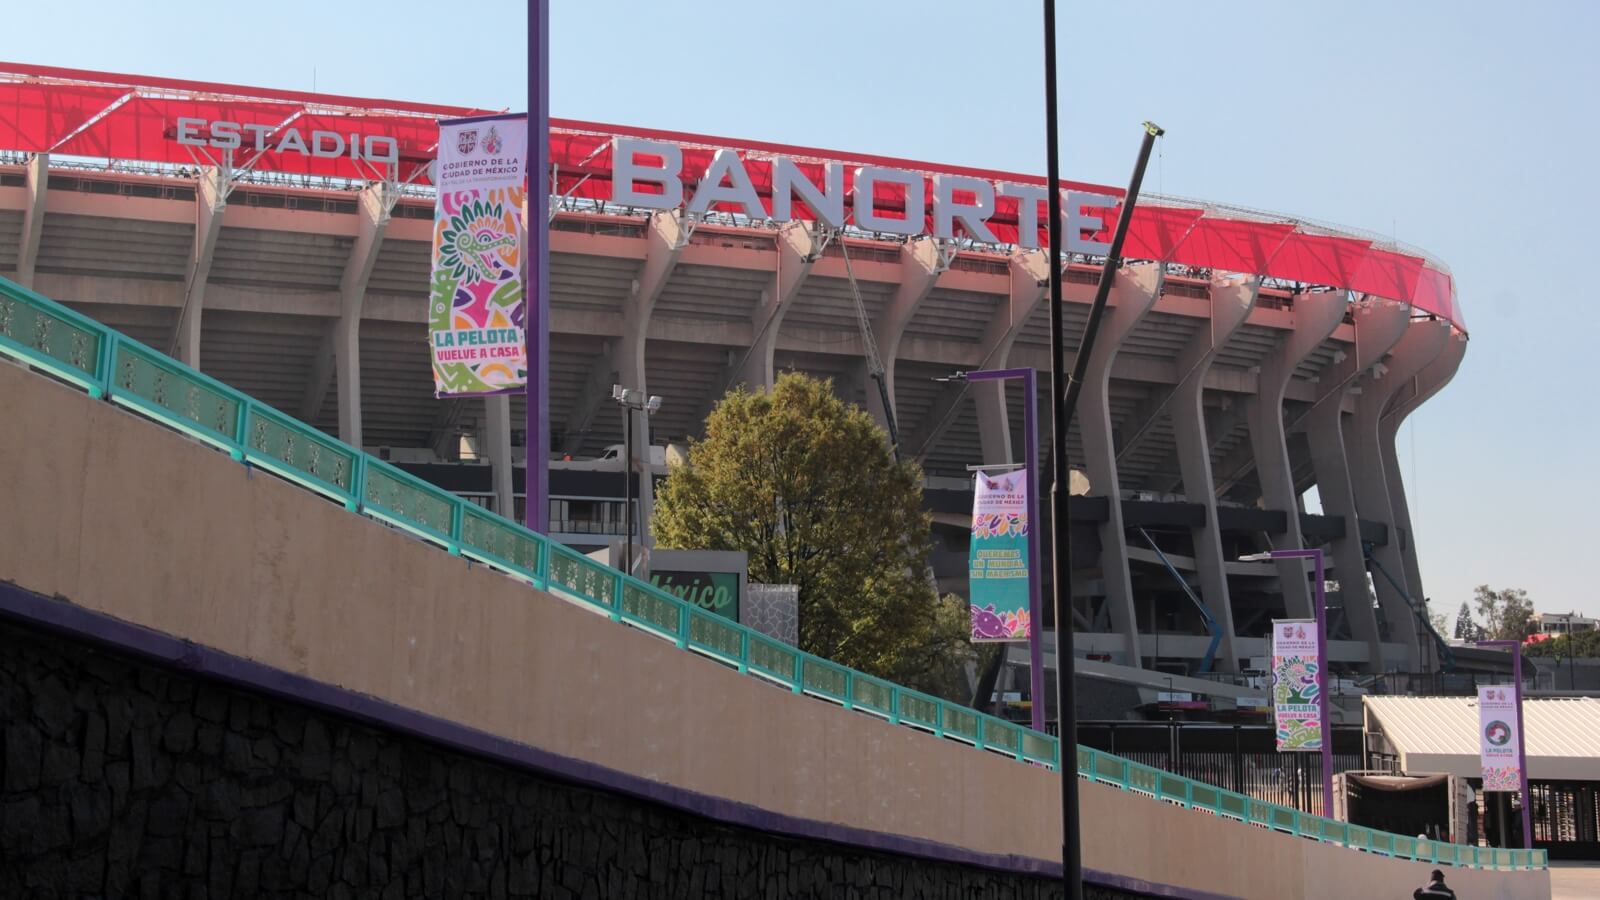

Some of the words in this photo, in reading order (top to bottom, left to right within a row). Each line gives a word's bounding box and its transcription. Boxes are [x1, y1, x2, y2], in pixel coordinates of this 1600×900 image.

[177, 116, 399, 163] ESTADIO
[442, 159, 488, 170] GOBIERNO
[442, 170, 470, 179] CIUDAD
[486, 166, 518, 174] MÉXICO
[611, 135, 1117, 256] BANORTE
[435, 332, 454, 347] LA
[458, 329, 518, 346] PELOTA
[438, 349, 477, 360] VUELVE
[480, 348, 488, 358] A
[490, 346, 520, 358] CASA
